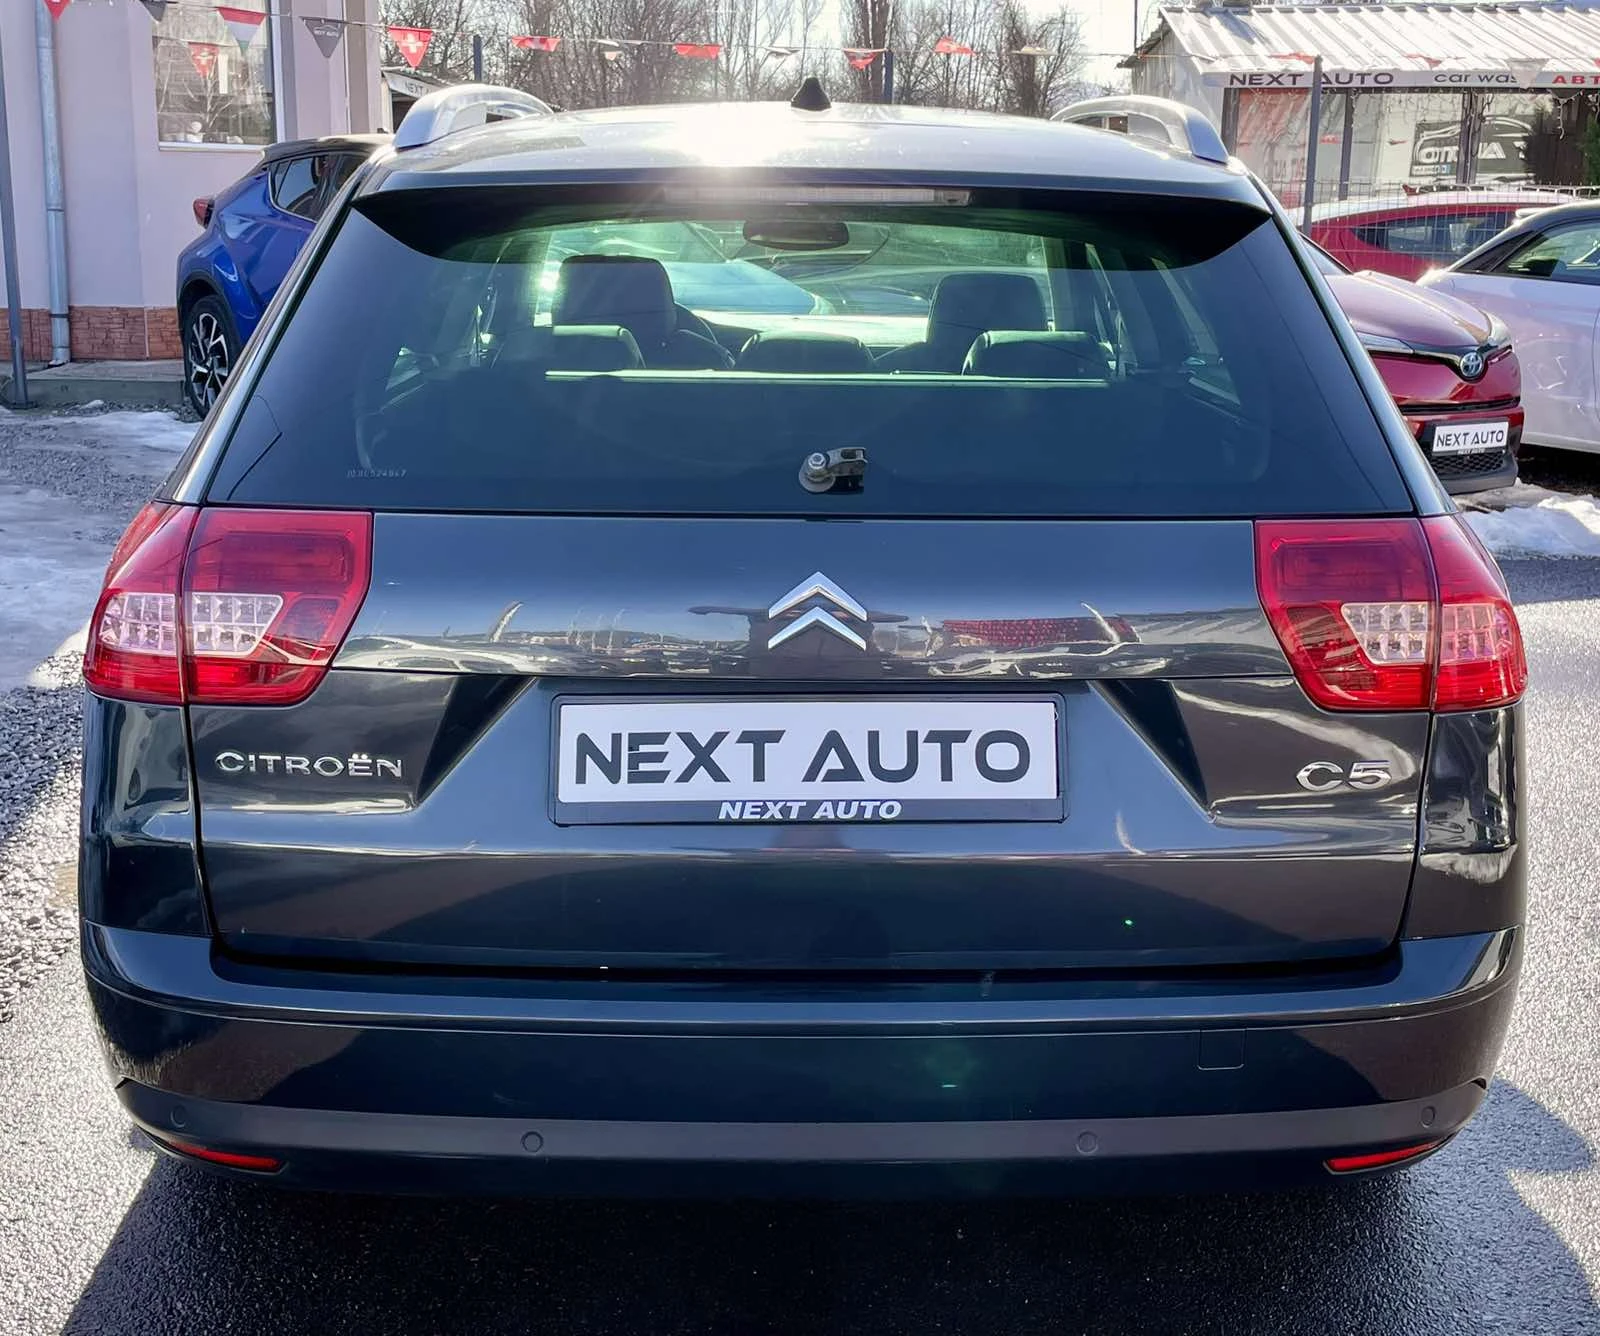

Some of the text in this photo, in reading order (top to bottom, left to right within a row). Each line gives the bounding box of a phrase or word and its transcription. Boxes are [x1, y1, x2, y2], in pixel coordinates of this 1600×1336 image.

[1229, 73, 1303, 86] NEXT
[1434, 73, 1518, 83] car was
[1436, 430, 1504, 447] NEXT AUTO
[215, 752, 402, 777] CITROËN
[575, 729, 1031, 784] NEXT AUTO
[1296, 760, 1392, 791] C5
[718, 800, 902, 820] NEXT AUTO
